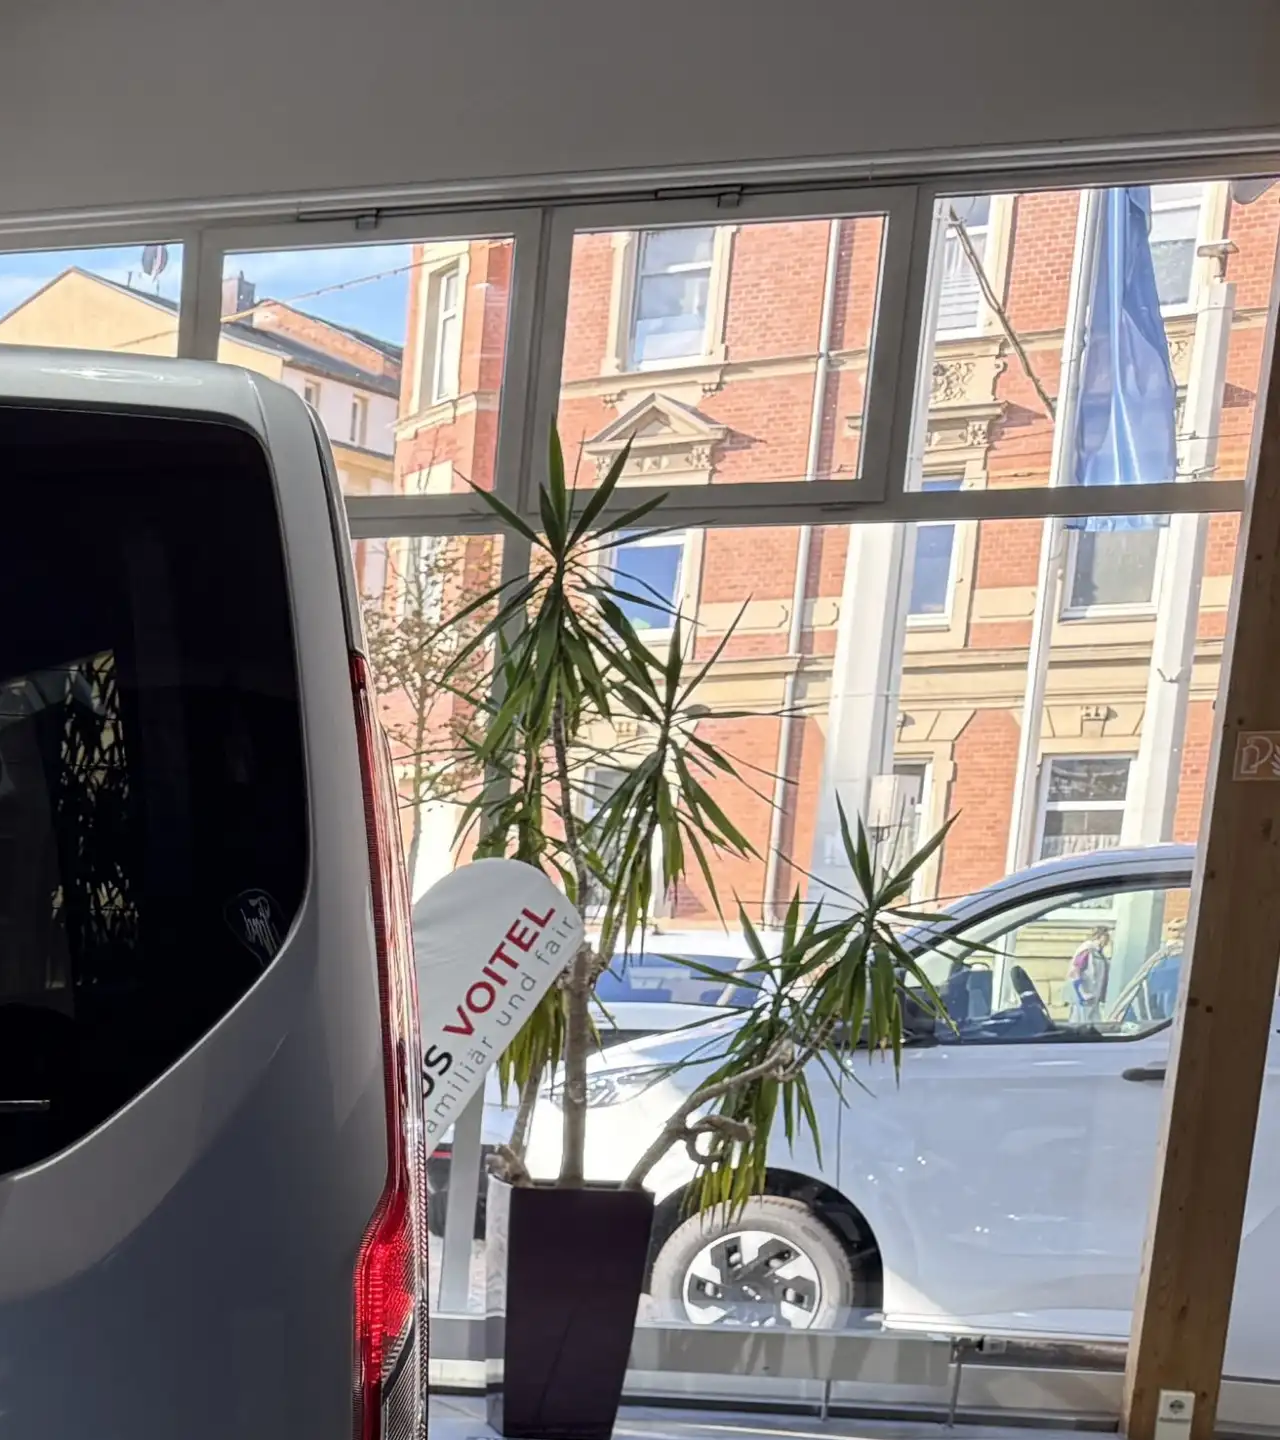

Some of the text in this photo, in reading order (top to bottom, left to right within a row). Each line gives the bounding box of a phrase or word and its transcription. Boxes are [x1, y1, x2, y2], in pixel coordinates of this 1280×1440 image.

[443, 905, 556, 1039] VOITEL
[496, 971, 537, 1027] und
[537, 915, 576, 966] fair
